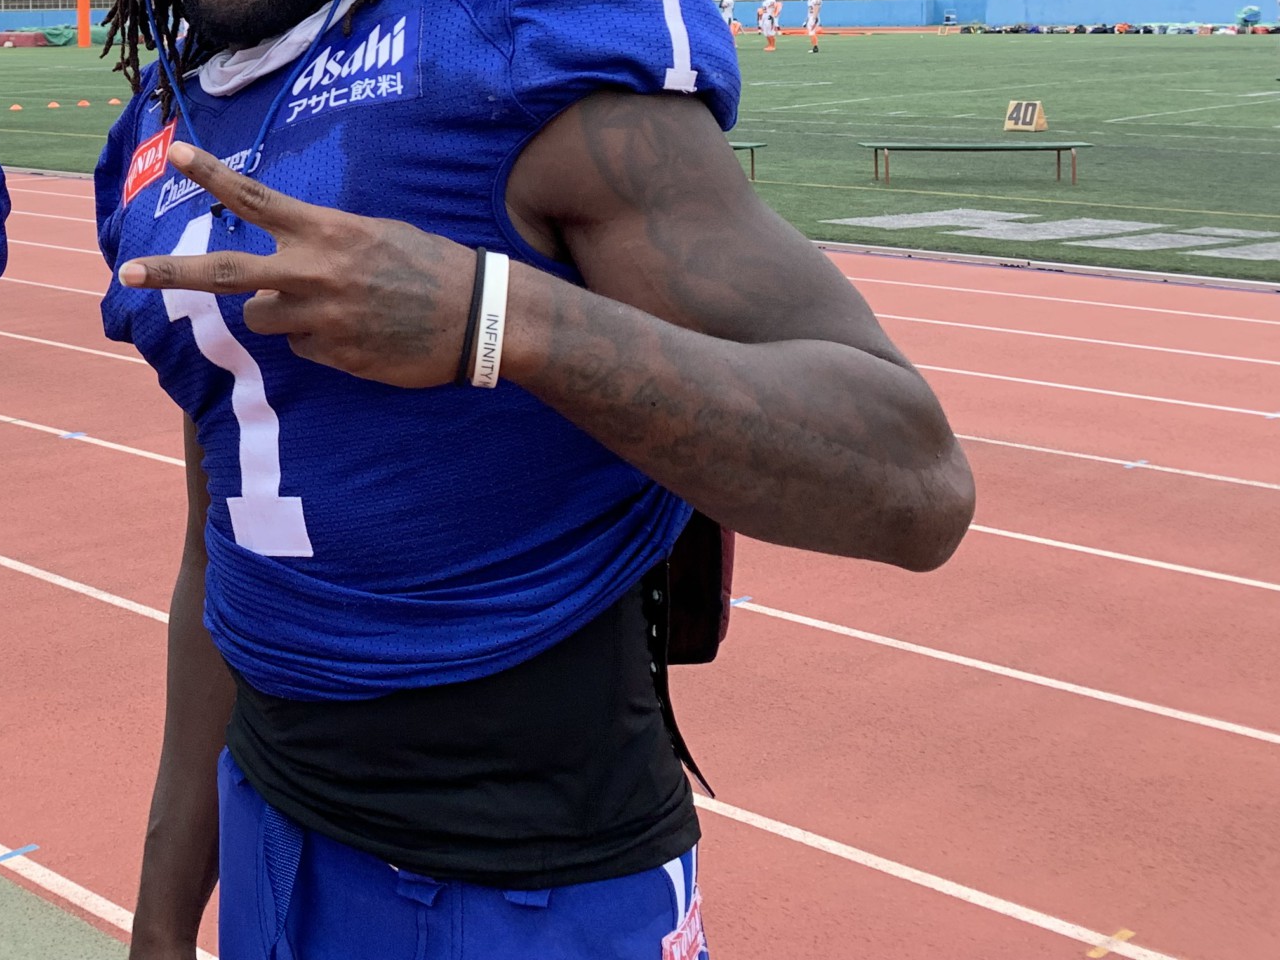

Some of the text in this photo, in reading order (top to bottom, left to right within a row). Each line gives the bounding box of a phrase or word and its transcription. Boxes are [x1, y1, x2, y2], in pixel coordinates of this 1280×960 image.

[292, 15, 406, 96] Asahi
[286, 71, 404, 123] アサヒ飲料
[1008, 102, 1037, 126] 40
[480, 314, 499, 380] INFINITY
[161, 212, 314, 557] 1
